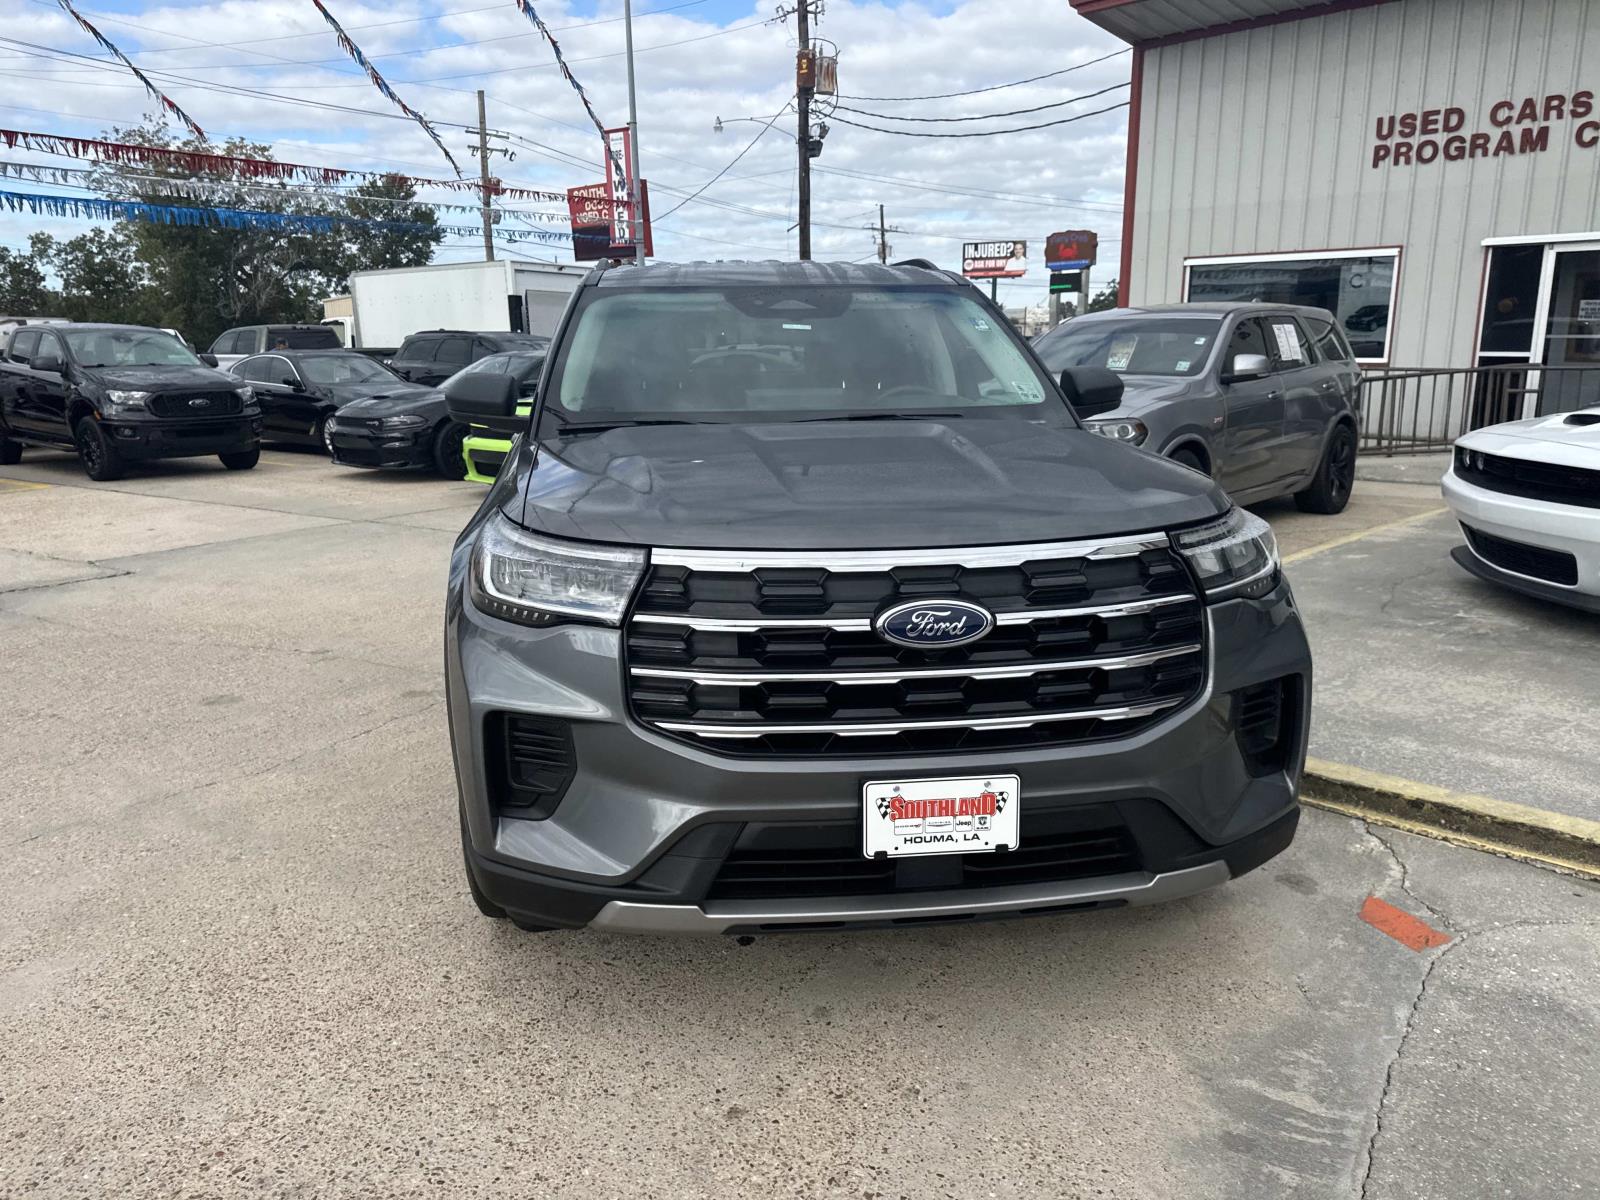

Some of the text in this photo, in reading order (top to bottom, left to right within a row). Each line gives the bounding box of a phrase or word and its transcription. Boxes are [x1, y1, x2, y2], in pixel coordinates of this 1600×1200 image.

[1376, 90, 1594, 141] USED CARS
[1372, 120, 1600, 169] PROGRAM C
[964, 242, 1014, 259] INJURED?
[906, 610, 967, 638] Ford
[956, 819, 972, 827] Jeep
[904, 833, 980, 844] HOUMA, LA
